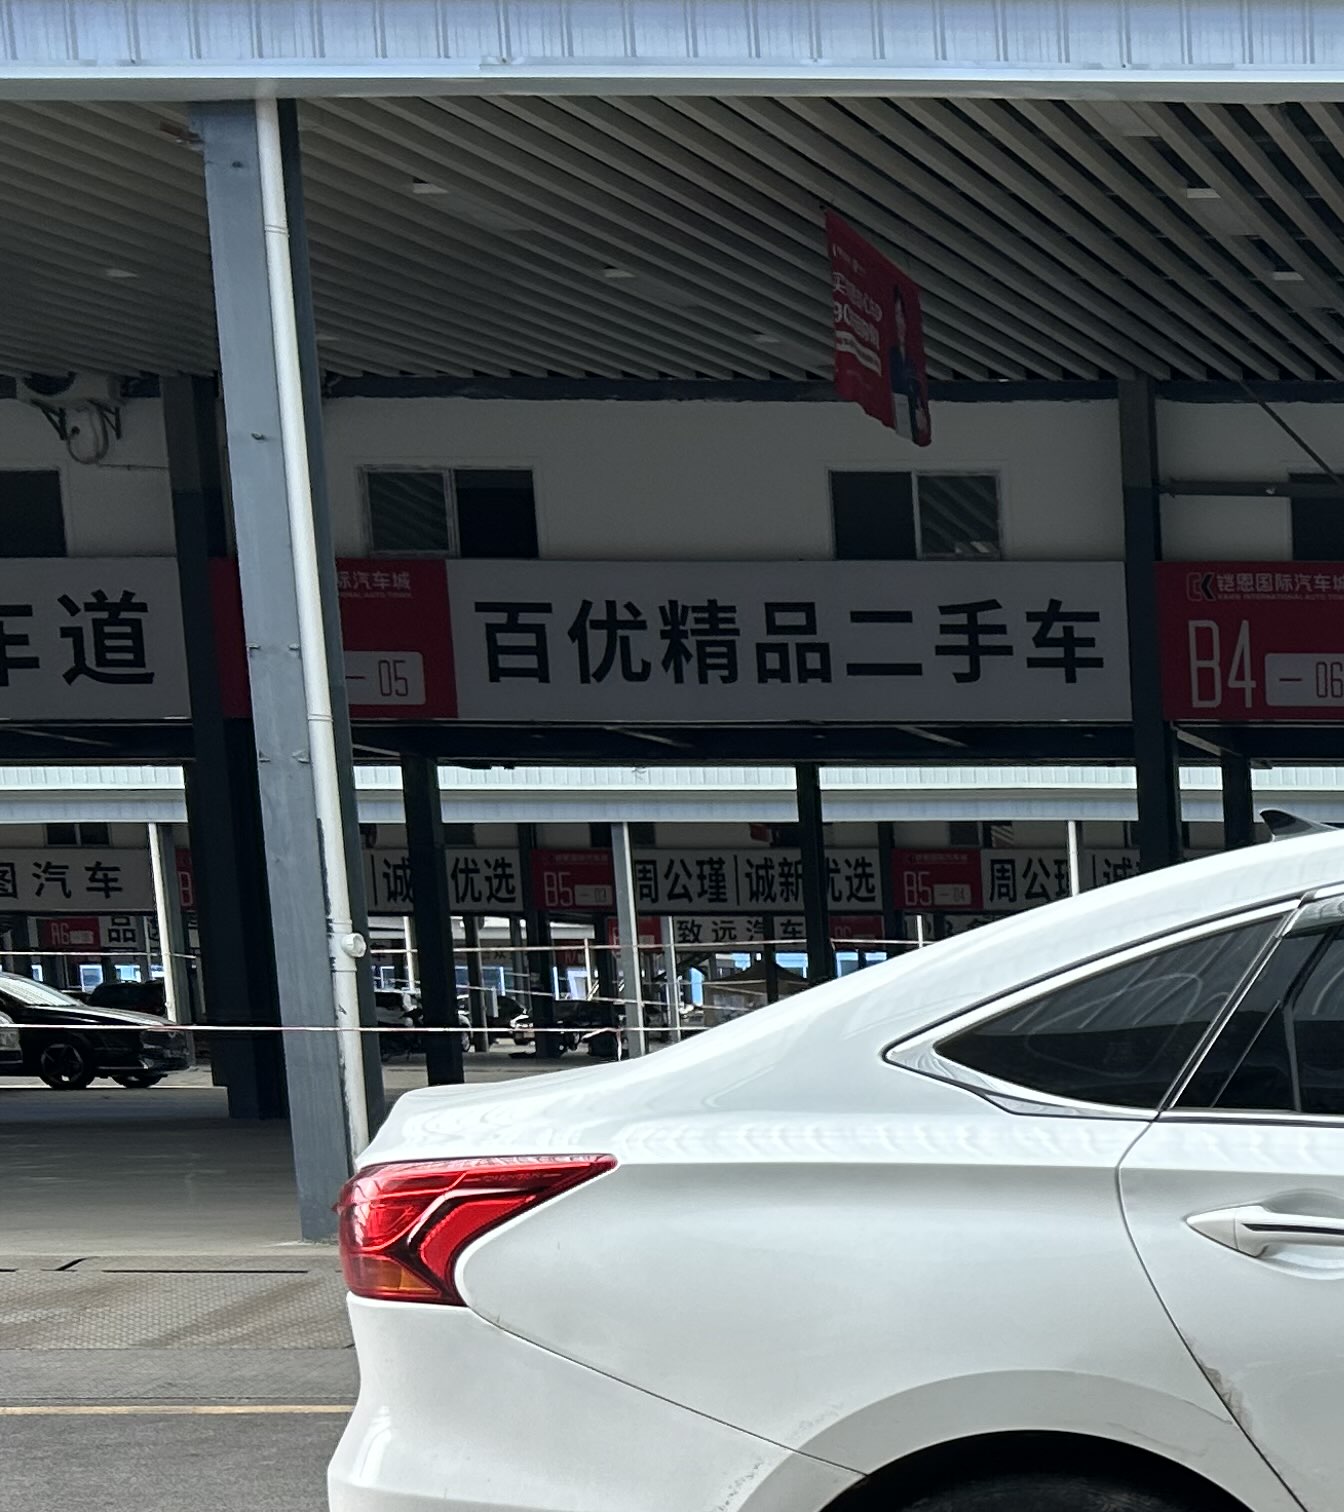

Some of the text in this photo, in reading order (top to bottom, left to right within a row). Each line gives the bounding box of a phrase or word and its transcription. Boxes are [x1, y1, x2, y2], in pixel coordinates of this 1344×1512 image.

[474, 598, 1104, 684] 百优精品二手车
